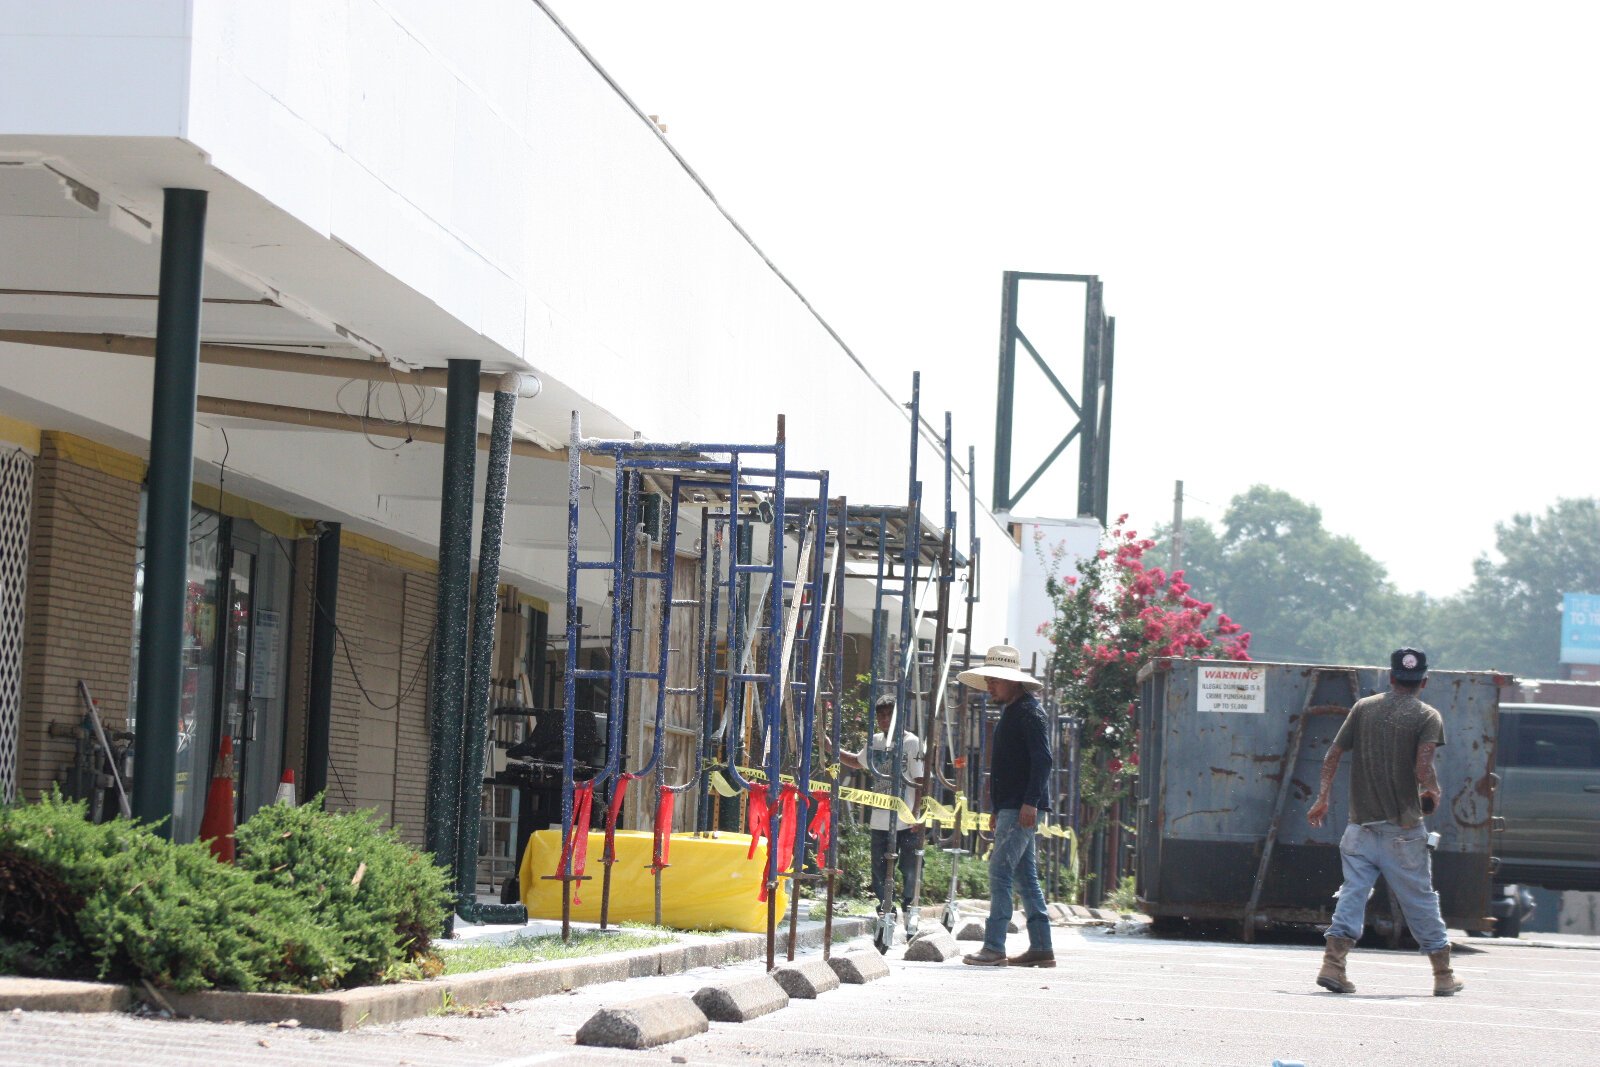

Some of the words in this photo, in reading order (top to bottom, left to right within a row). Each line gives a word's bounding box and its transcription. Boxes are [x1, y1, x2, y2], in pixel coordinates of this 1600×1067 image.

[1205, 670, 1258, 680] WARNING
[1206, 692, 1222, 700] CRIME
[1223, 693, 1256, 701] PUNISHABLE
[861, 793, 900, 809] CAUTION
